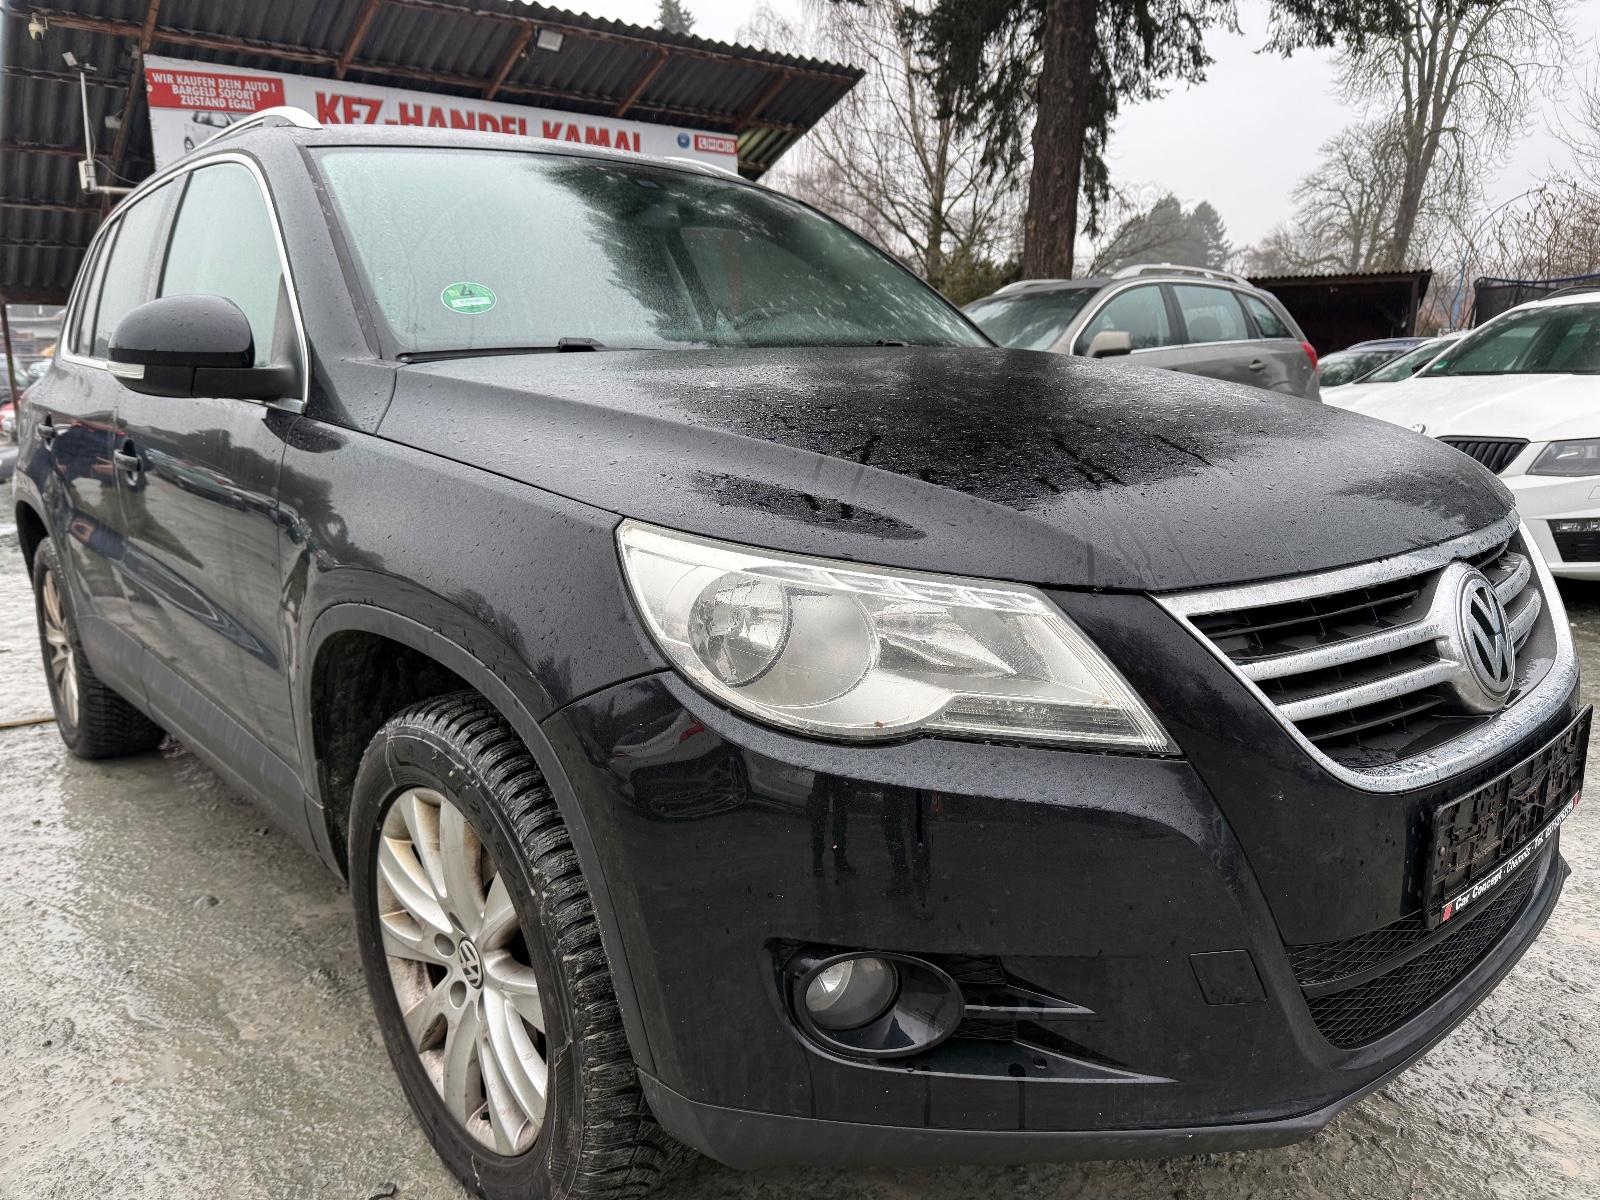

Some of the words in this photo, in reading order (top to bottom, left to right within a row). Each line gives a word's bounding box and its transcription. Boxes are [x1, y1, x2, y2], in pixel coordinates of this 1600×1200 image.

[152, 72, 174, 84] WIR
[176, 74, 216, 88] KAUFEN
[219, 79, 241, 90] DEIN
[244, 81, 269, 92] AUTO
[172, 84, 216, 97] BARGELD
[219, 88, 254, 100] SOFORT
[180, 95, 226, 108] ZUSTAND
